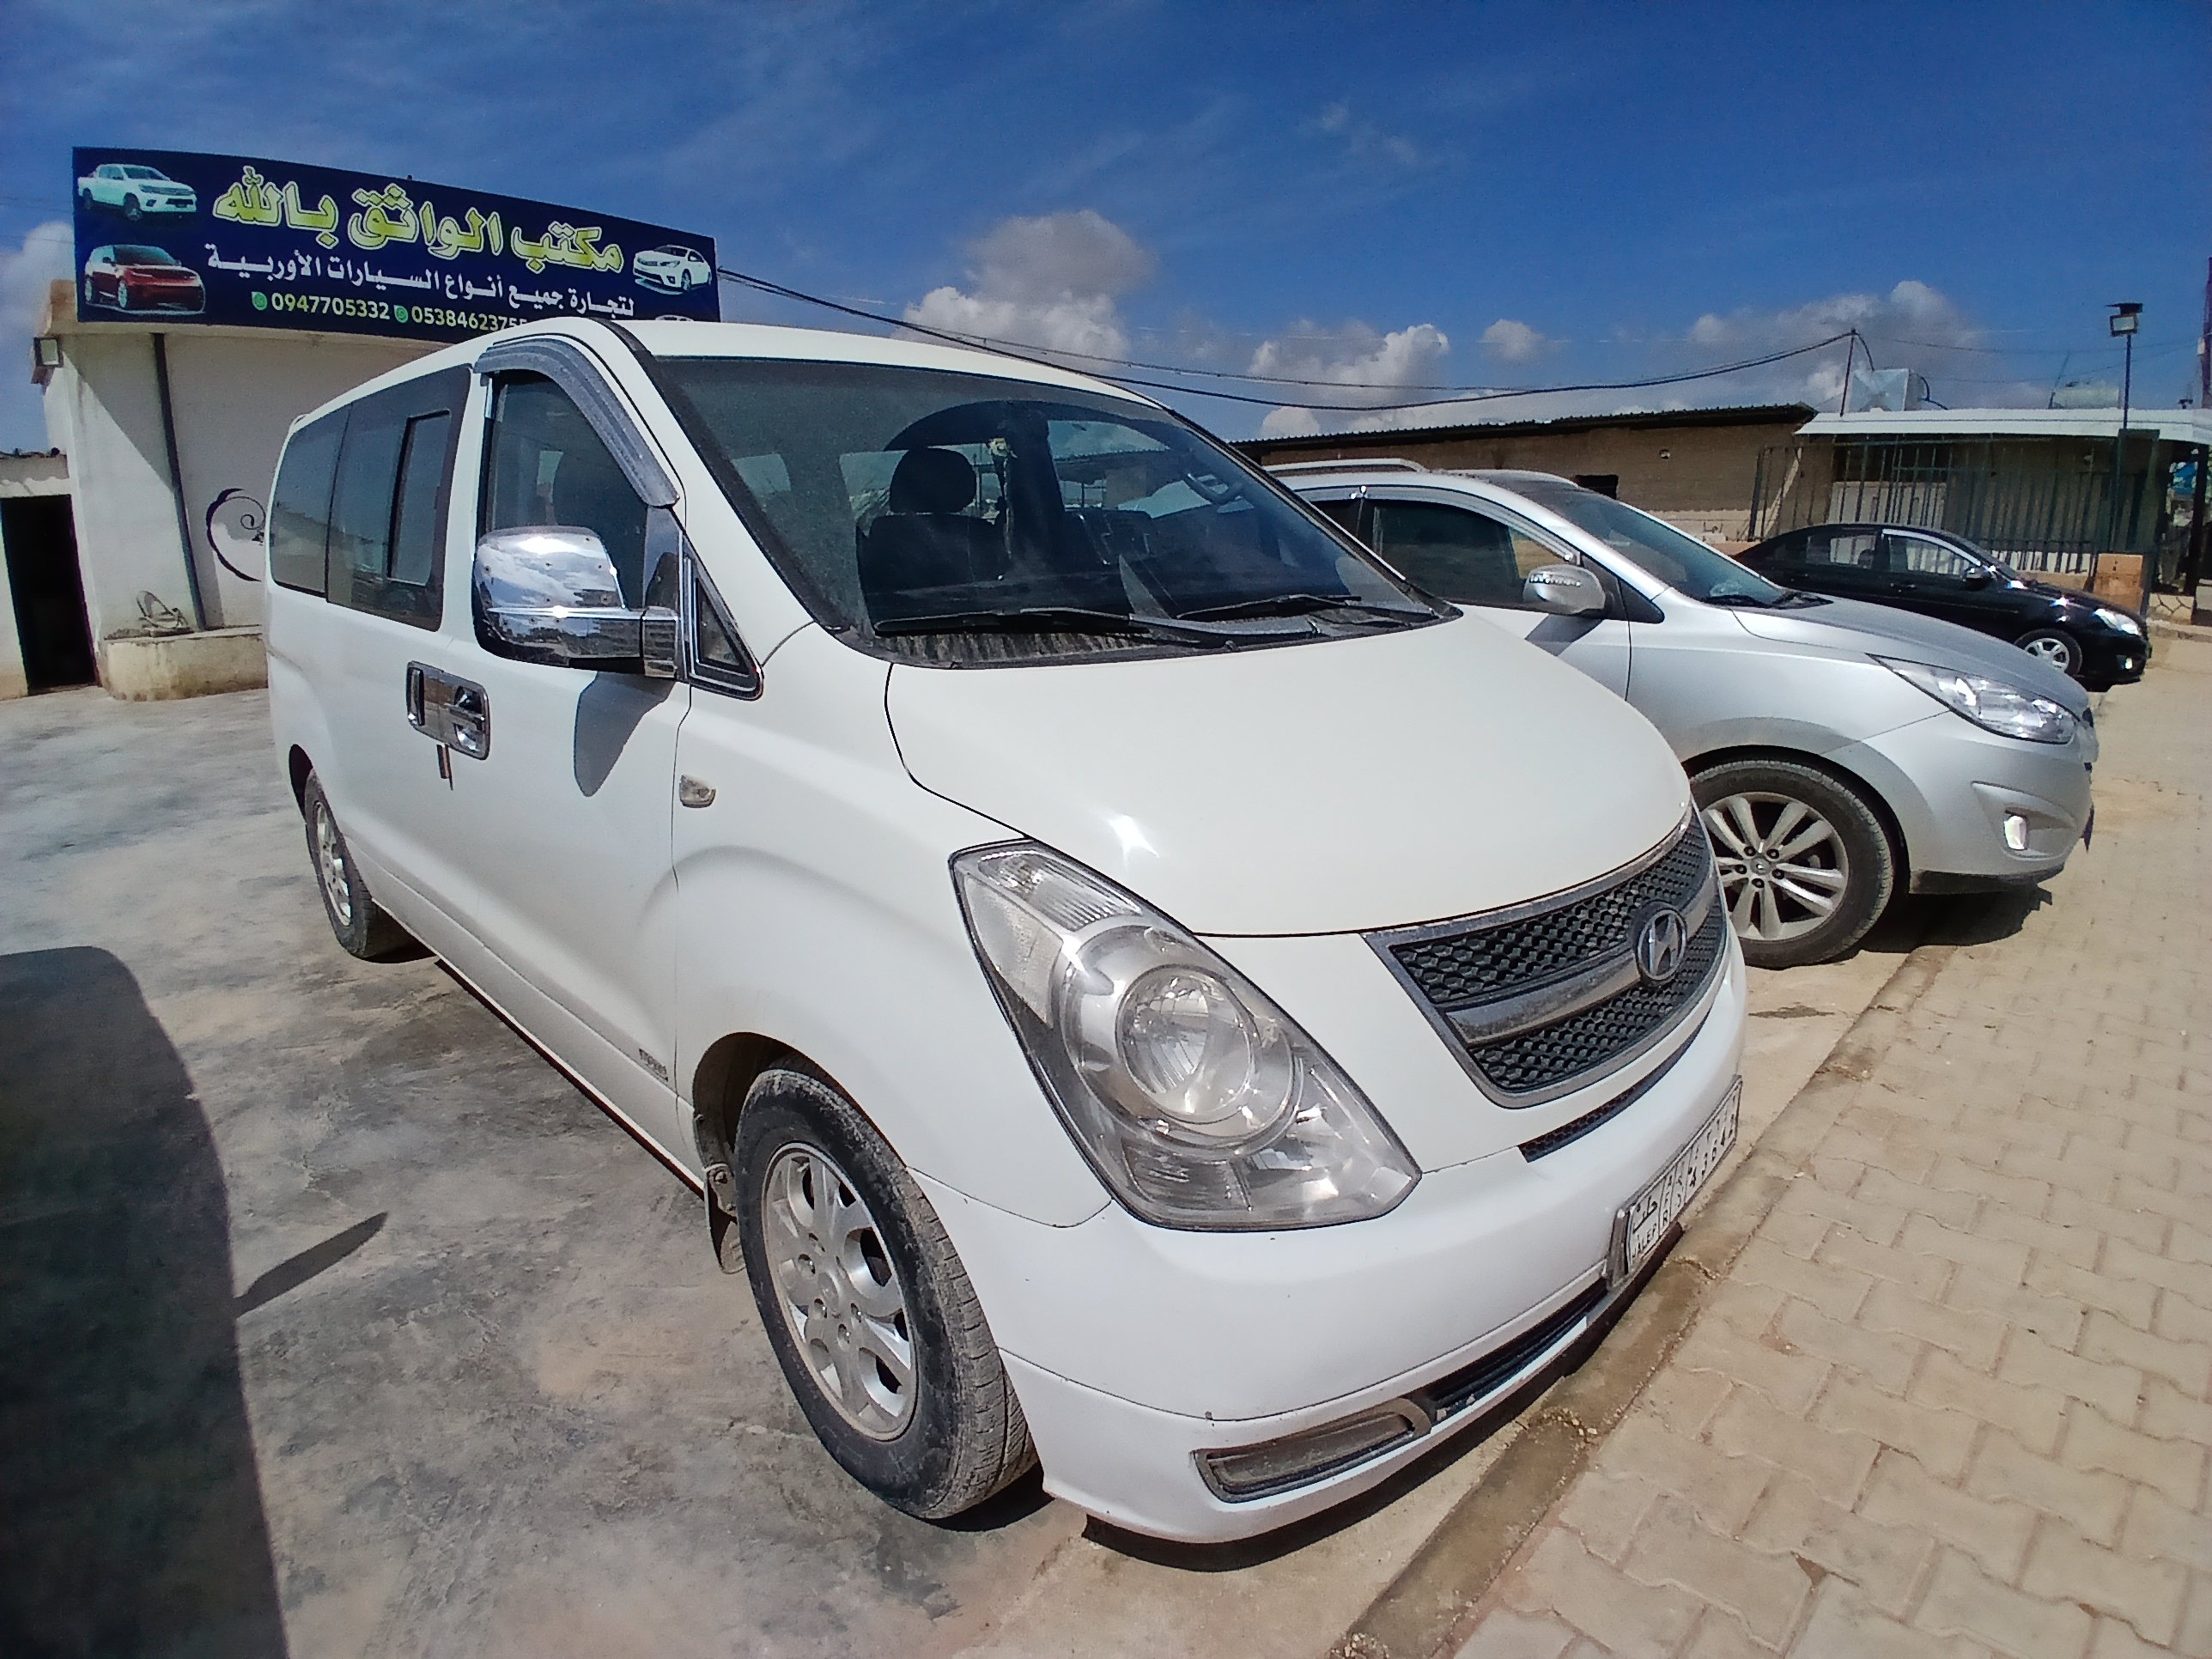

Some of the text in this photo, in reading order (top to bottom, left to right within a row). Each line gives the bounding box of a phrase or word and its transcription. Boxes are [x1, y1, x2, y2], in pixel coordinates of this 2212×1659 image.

[213, 166, 624, 274] مكتب الواثق بالله
[204, 243, 635, 319] لتجارة جميع أنواع السيارات الأوربية
[271, 292, 390, 320] 0947705332
